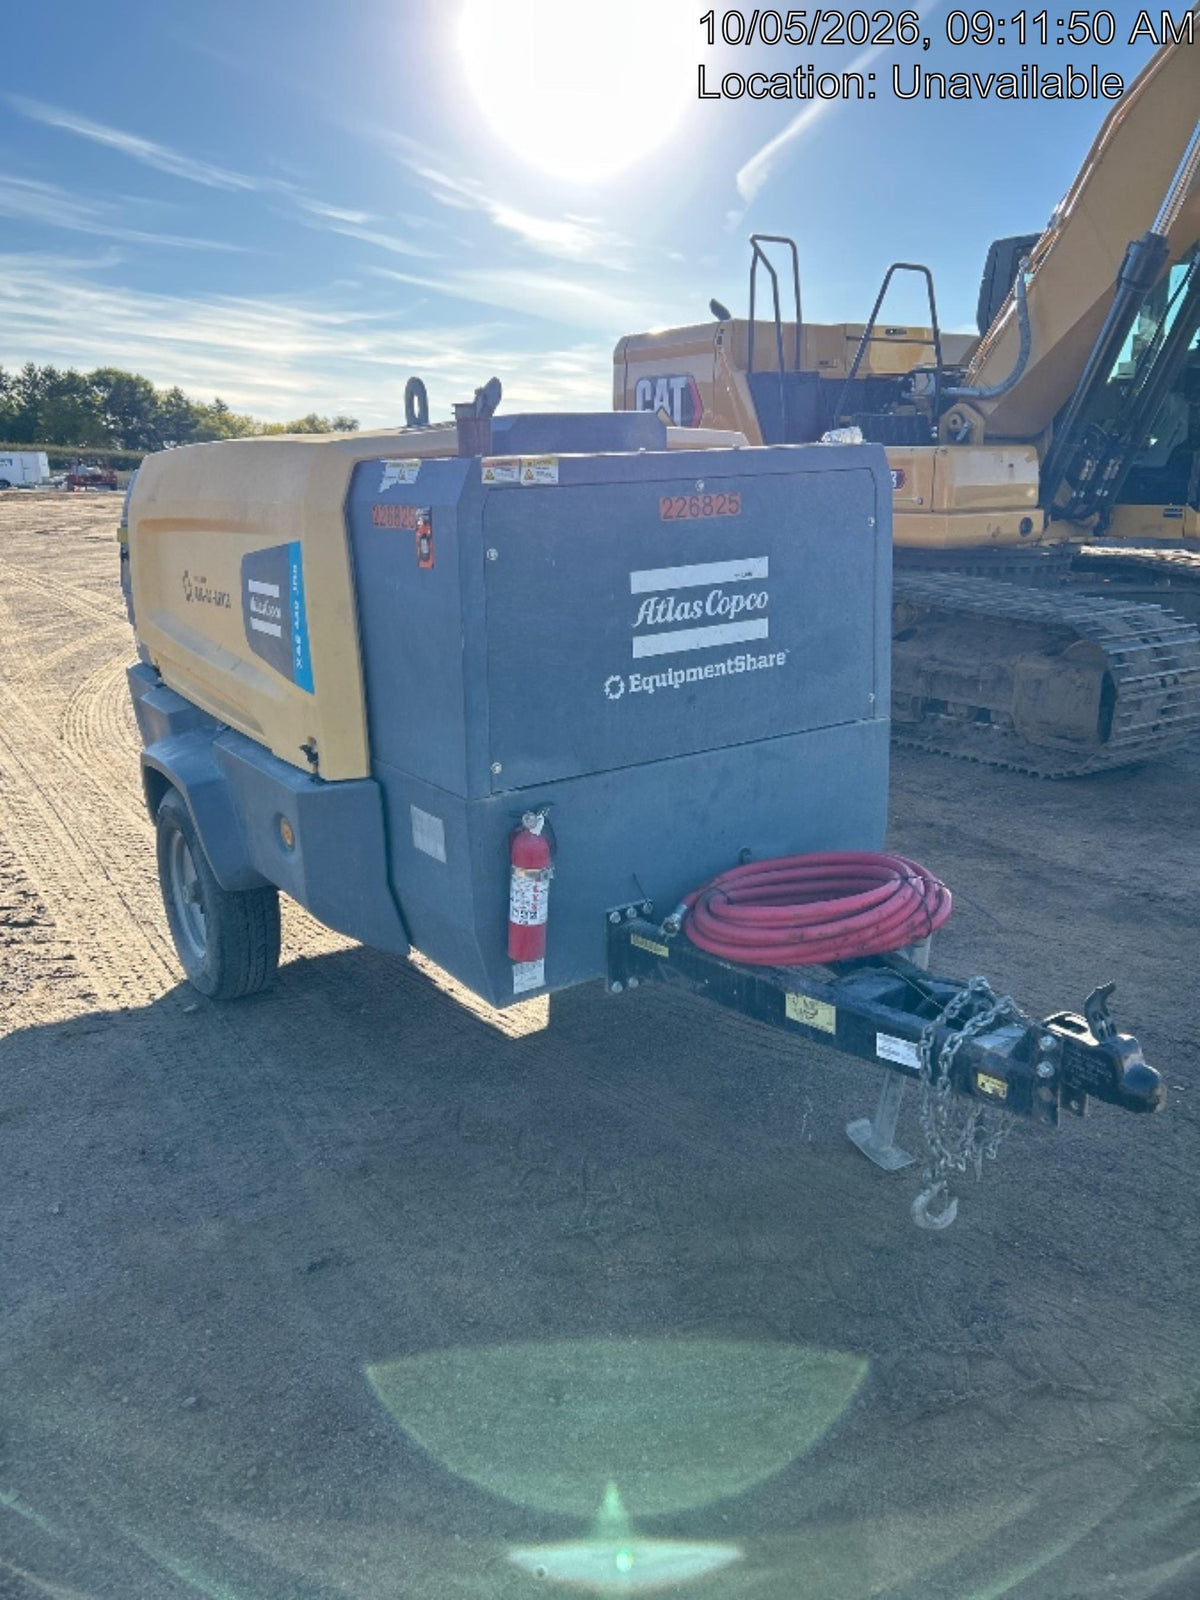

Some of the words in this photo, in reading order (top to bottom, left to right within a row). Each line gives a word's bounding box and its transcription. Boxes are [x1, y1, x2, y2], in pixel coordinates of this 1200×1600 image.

[635, 376, 686, 427] CAT
[661, 493, 741, 520] 226825
[628, 651, 787, 695] EquipmentShare
